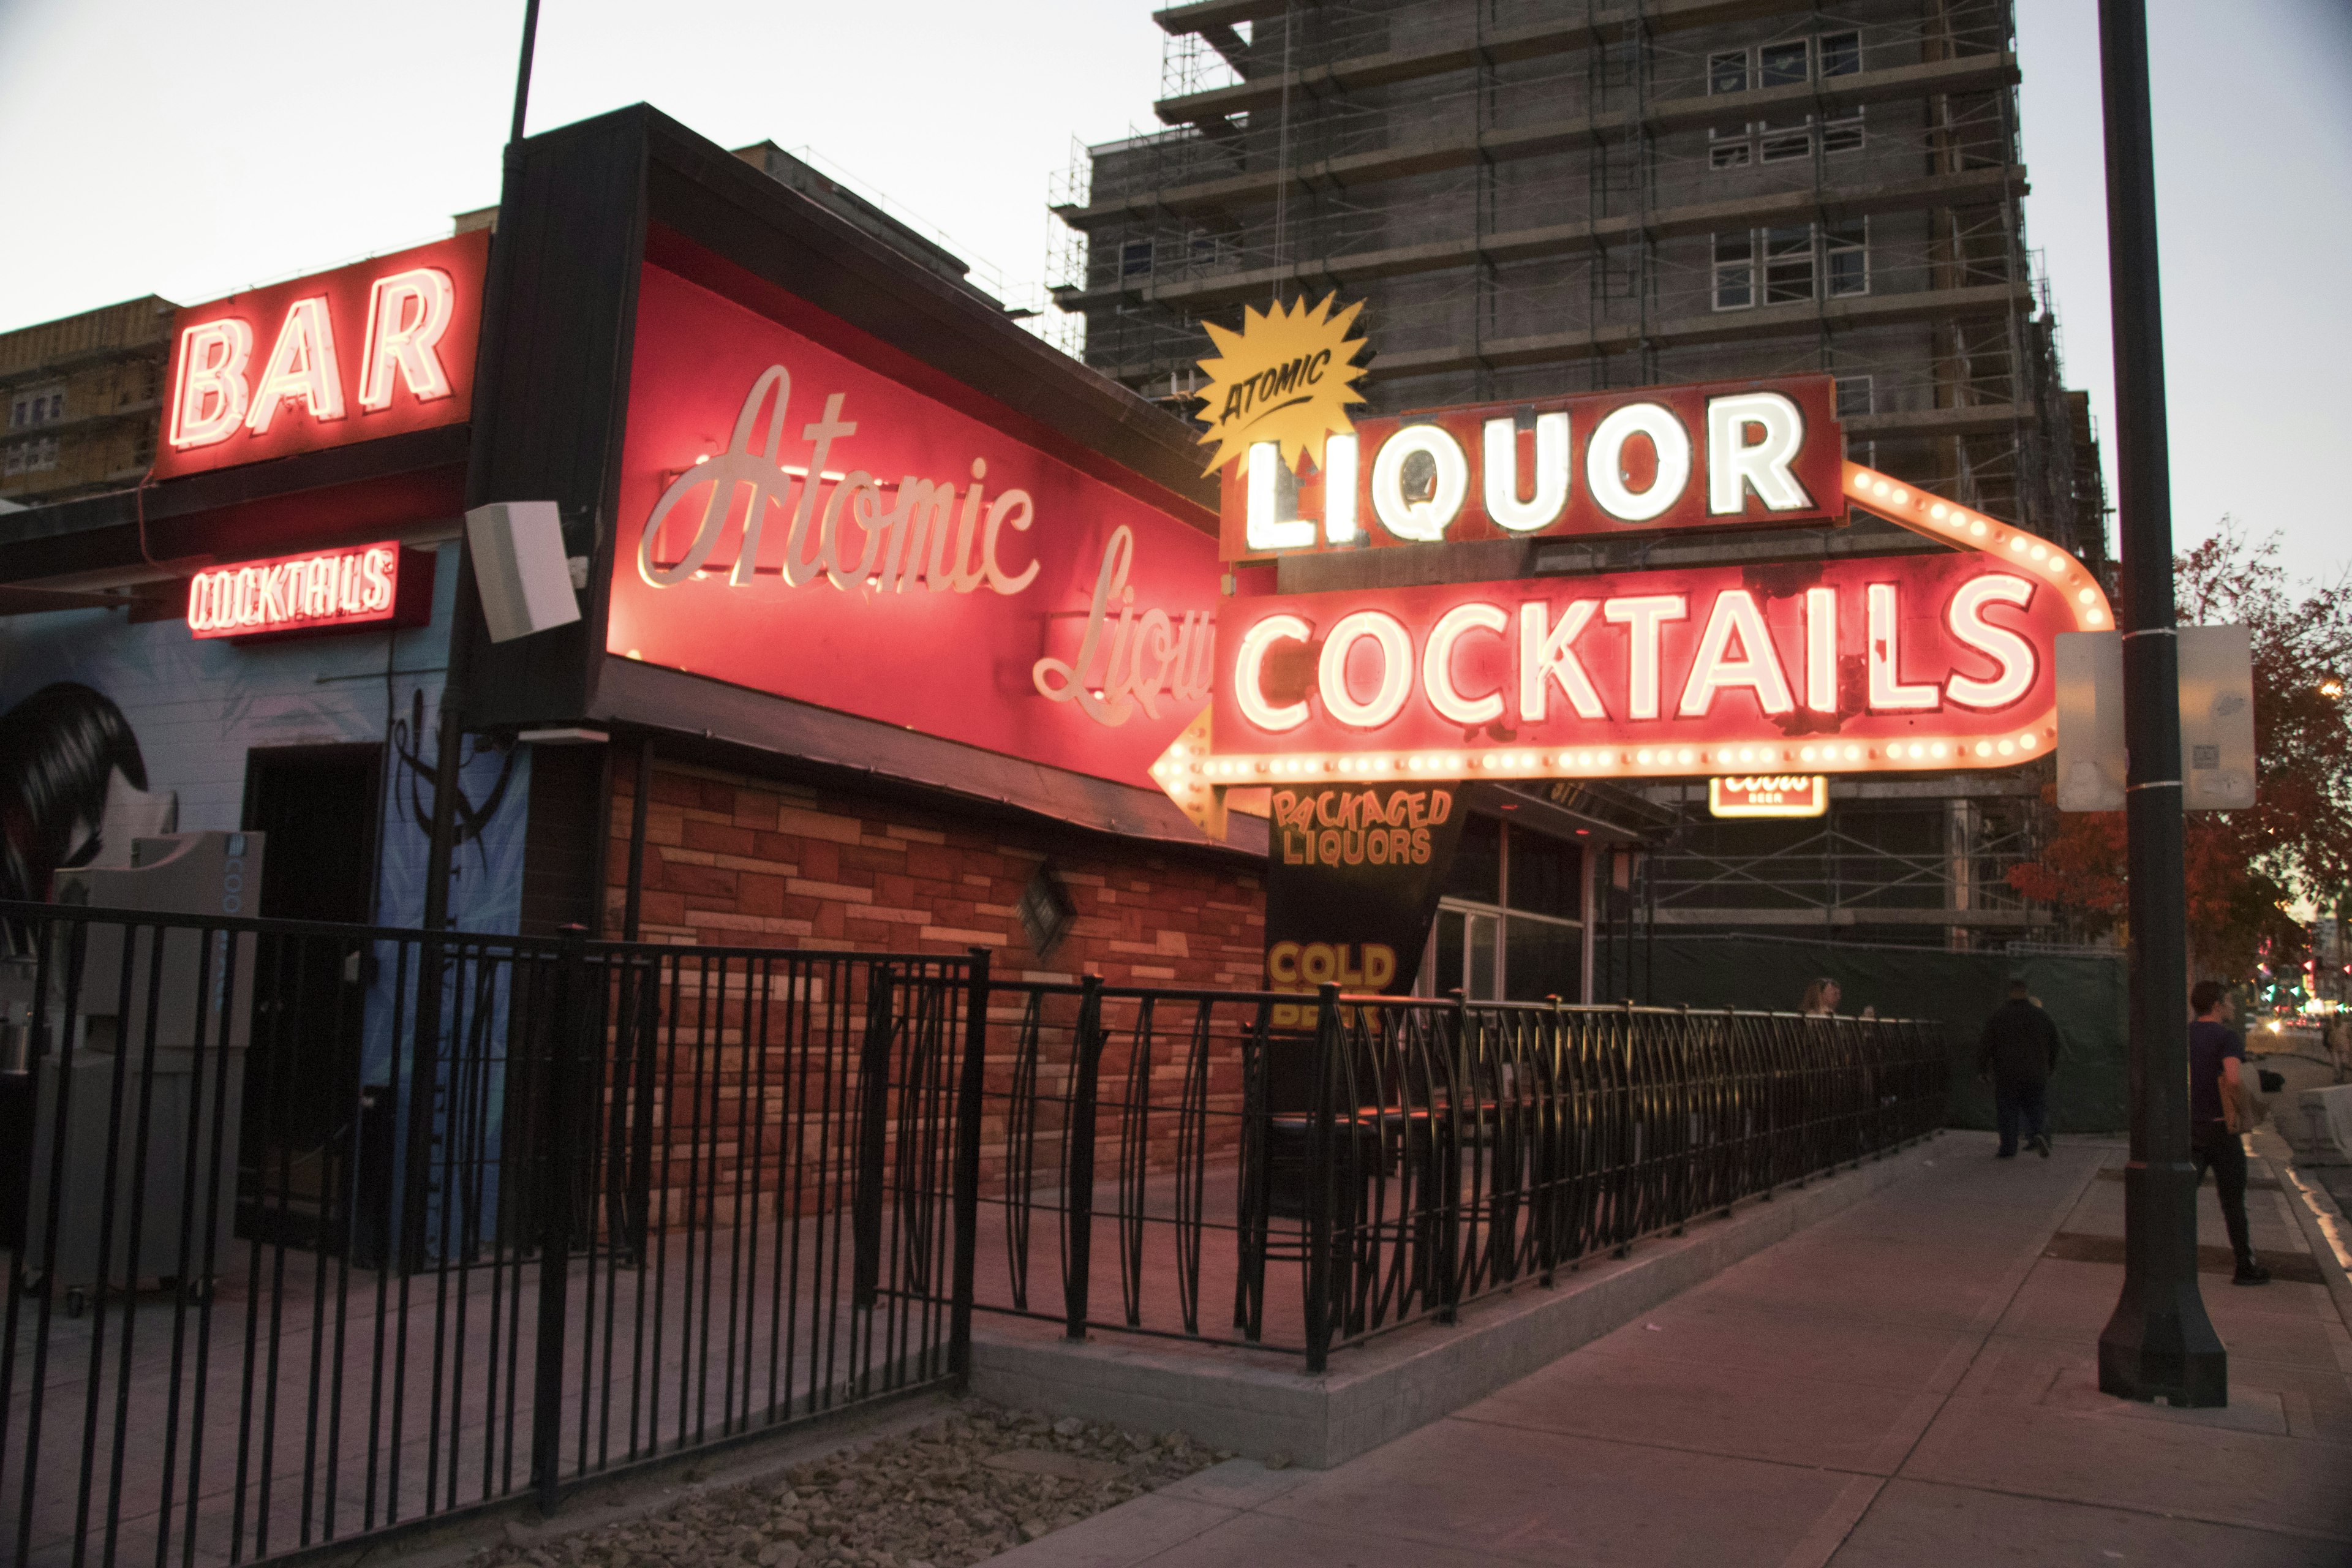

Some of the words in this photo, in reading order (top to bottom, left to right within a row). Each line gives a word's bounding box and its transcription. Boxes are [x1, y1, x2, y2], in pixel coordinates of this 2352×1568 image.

[169, 266, 454, 453] BAR
[1218, 348, 1332, 426] ATOMIC
[638, 364, 1040, 596] Atomic
[1246, 390, 1817, 551] LIQUOR
[187, 548, 394, 631] COCKTAILS
[1232, 572, 2038, 731] COCKTAILS
[1272, 789, 1452, 834] PACKAGED
[1748, 792, 1784, 804] BEER
[1283, 827, 1431, 868] LIQUORS
[1268, 941, 1396, 988] COLD
